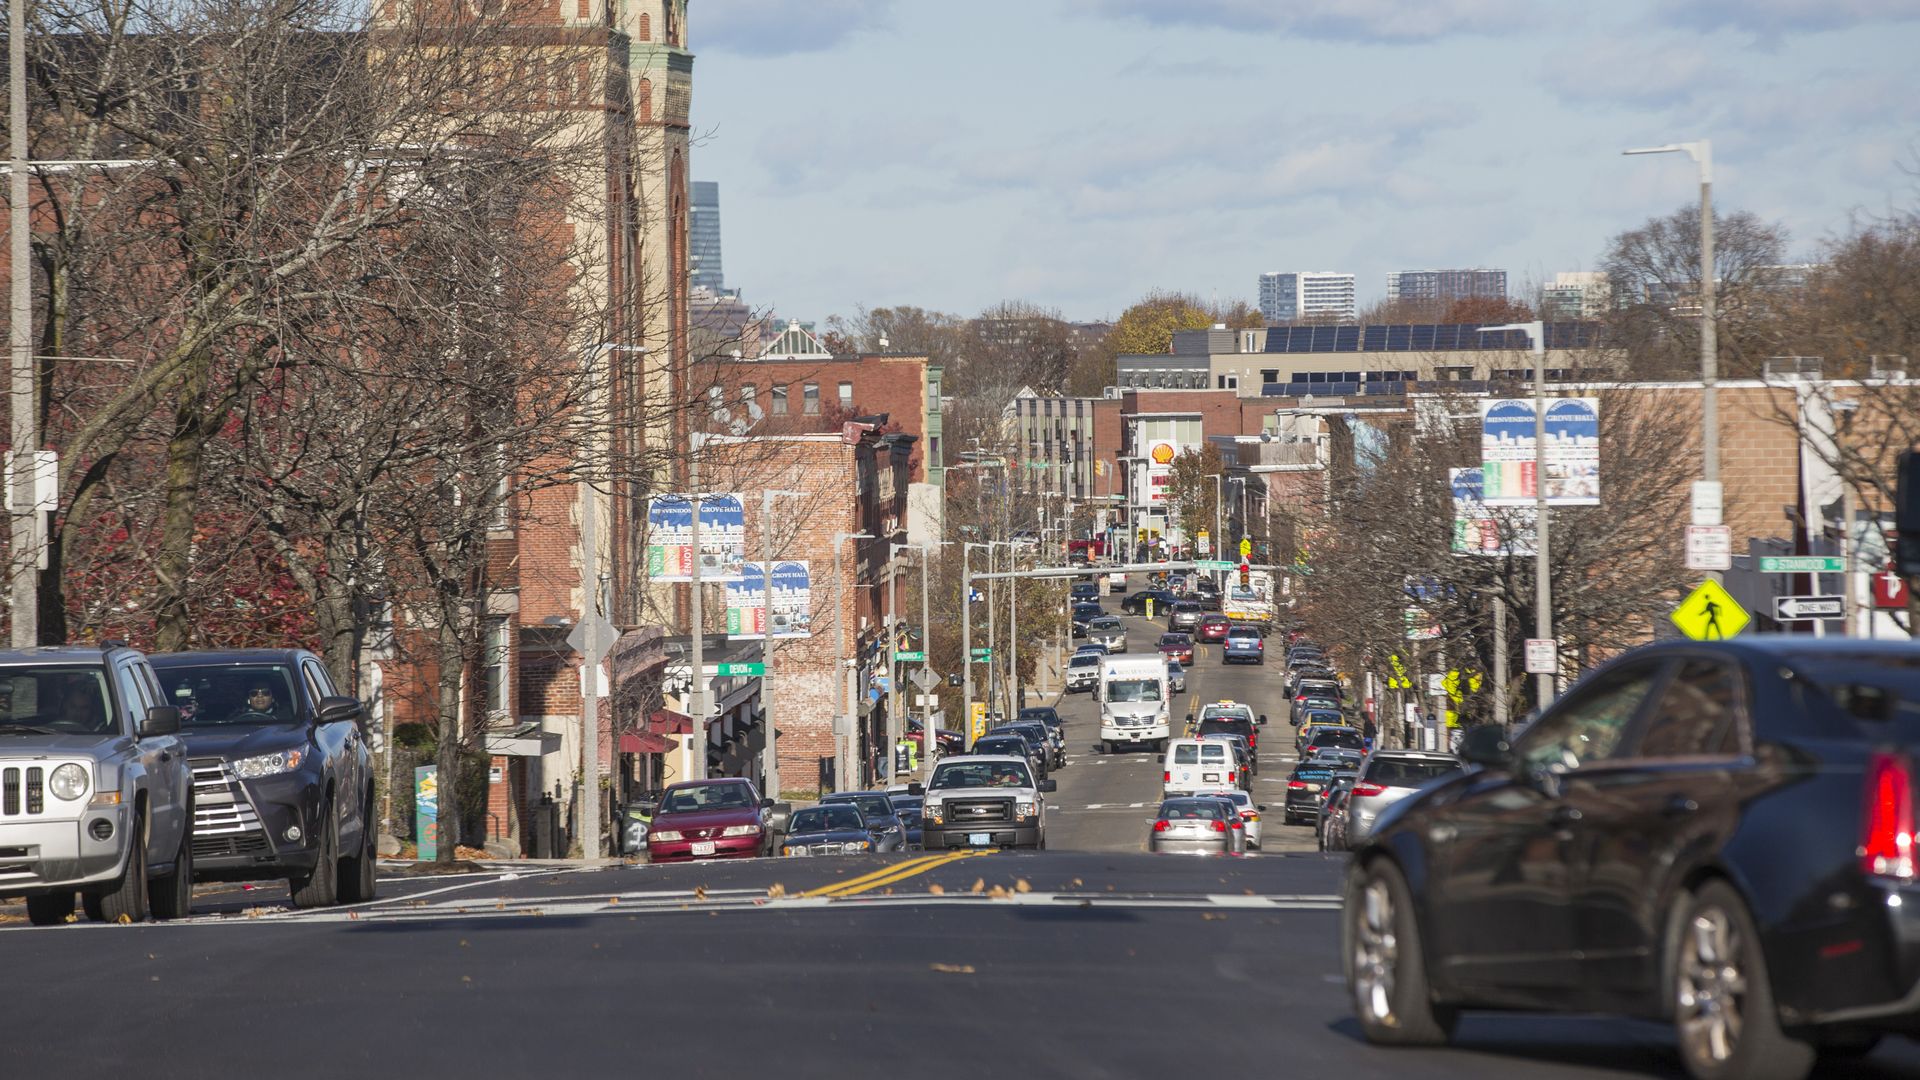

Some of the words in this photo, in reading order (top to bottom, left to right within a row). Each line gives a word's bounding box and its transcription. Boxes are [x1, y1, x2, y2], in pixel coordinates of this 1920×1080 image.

[1546, 414, 1573, 422] GROVE
[1576, 414, 1596, 422] HALL
[684, 546, 692, 574] ENJOY
[1778, 558, 1826, 570] STANWOOD
[1798, 604, 1817, 612] ONE
[1819, 602, 1840, 611] WAY
[729, 664, 748, 674] DEVON
